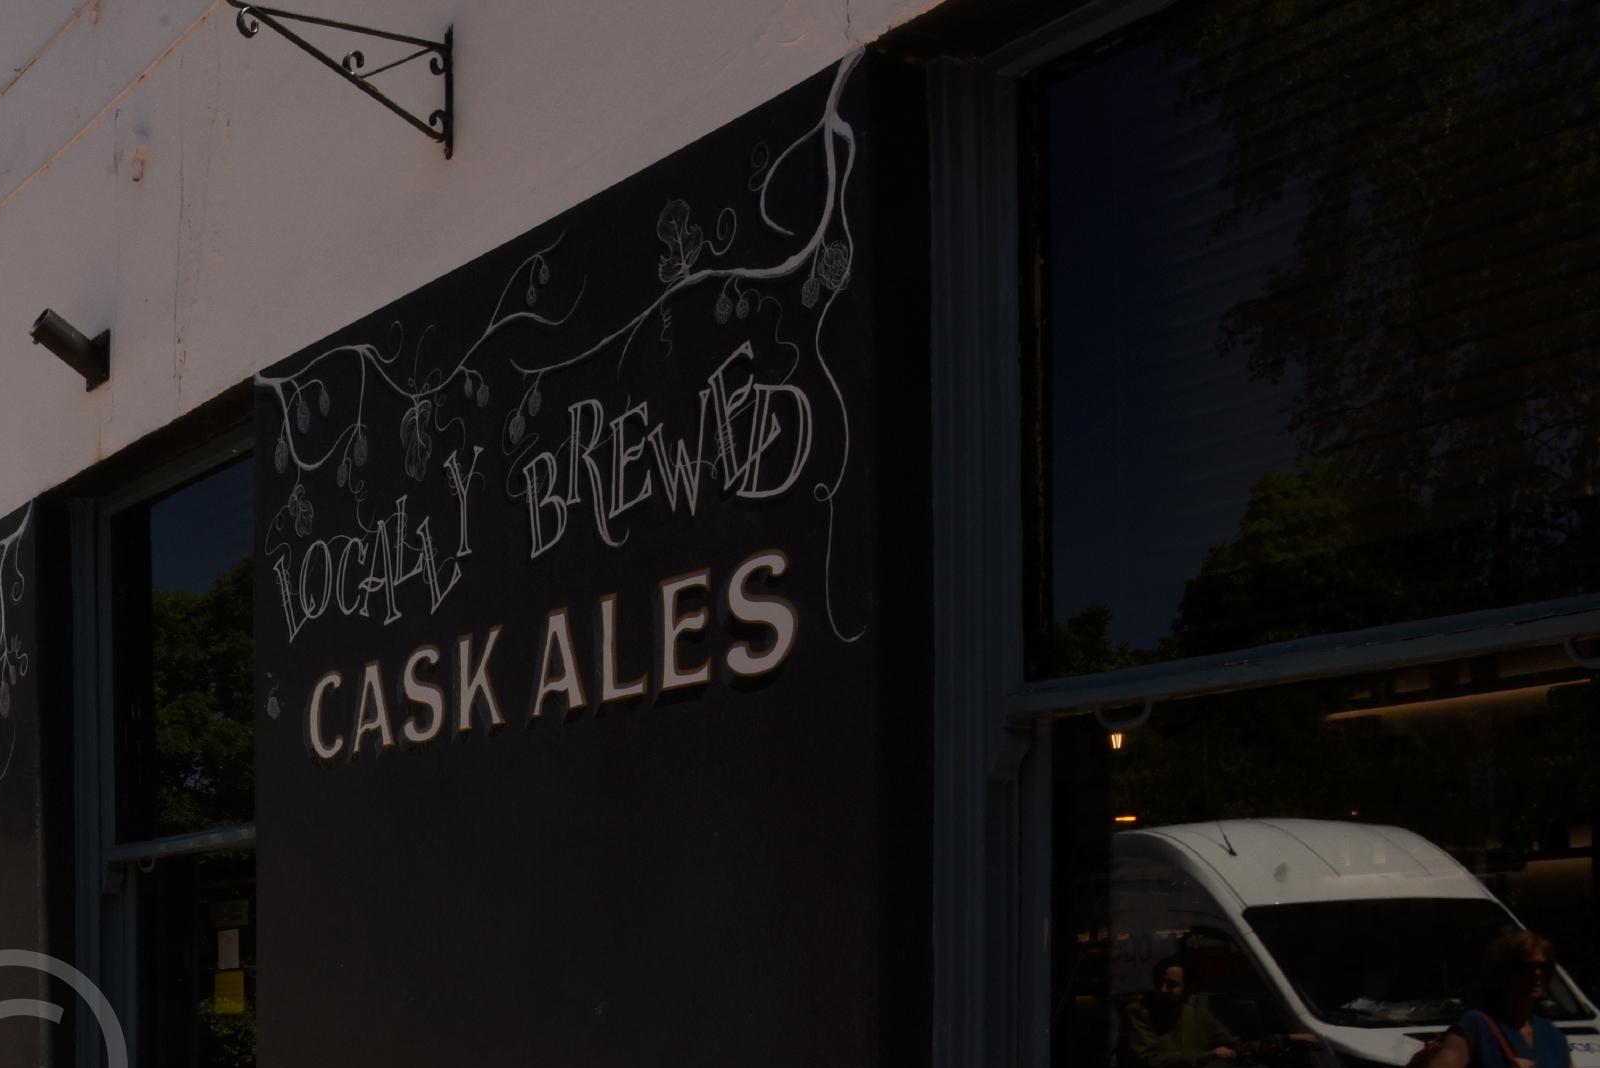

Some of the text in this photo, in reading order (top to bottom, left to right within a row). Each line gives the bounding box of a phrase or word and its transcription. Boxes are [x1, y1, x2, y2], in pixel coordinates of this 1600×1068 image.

[273, 340, 813, 643] LOCALLY BREWED
[307, 549, 800, 762] CASK ALES
